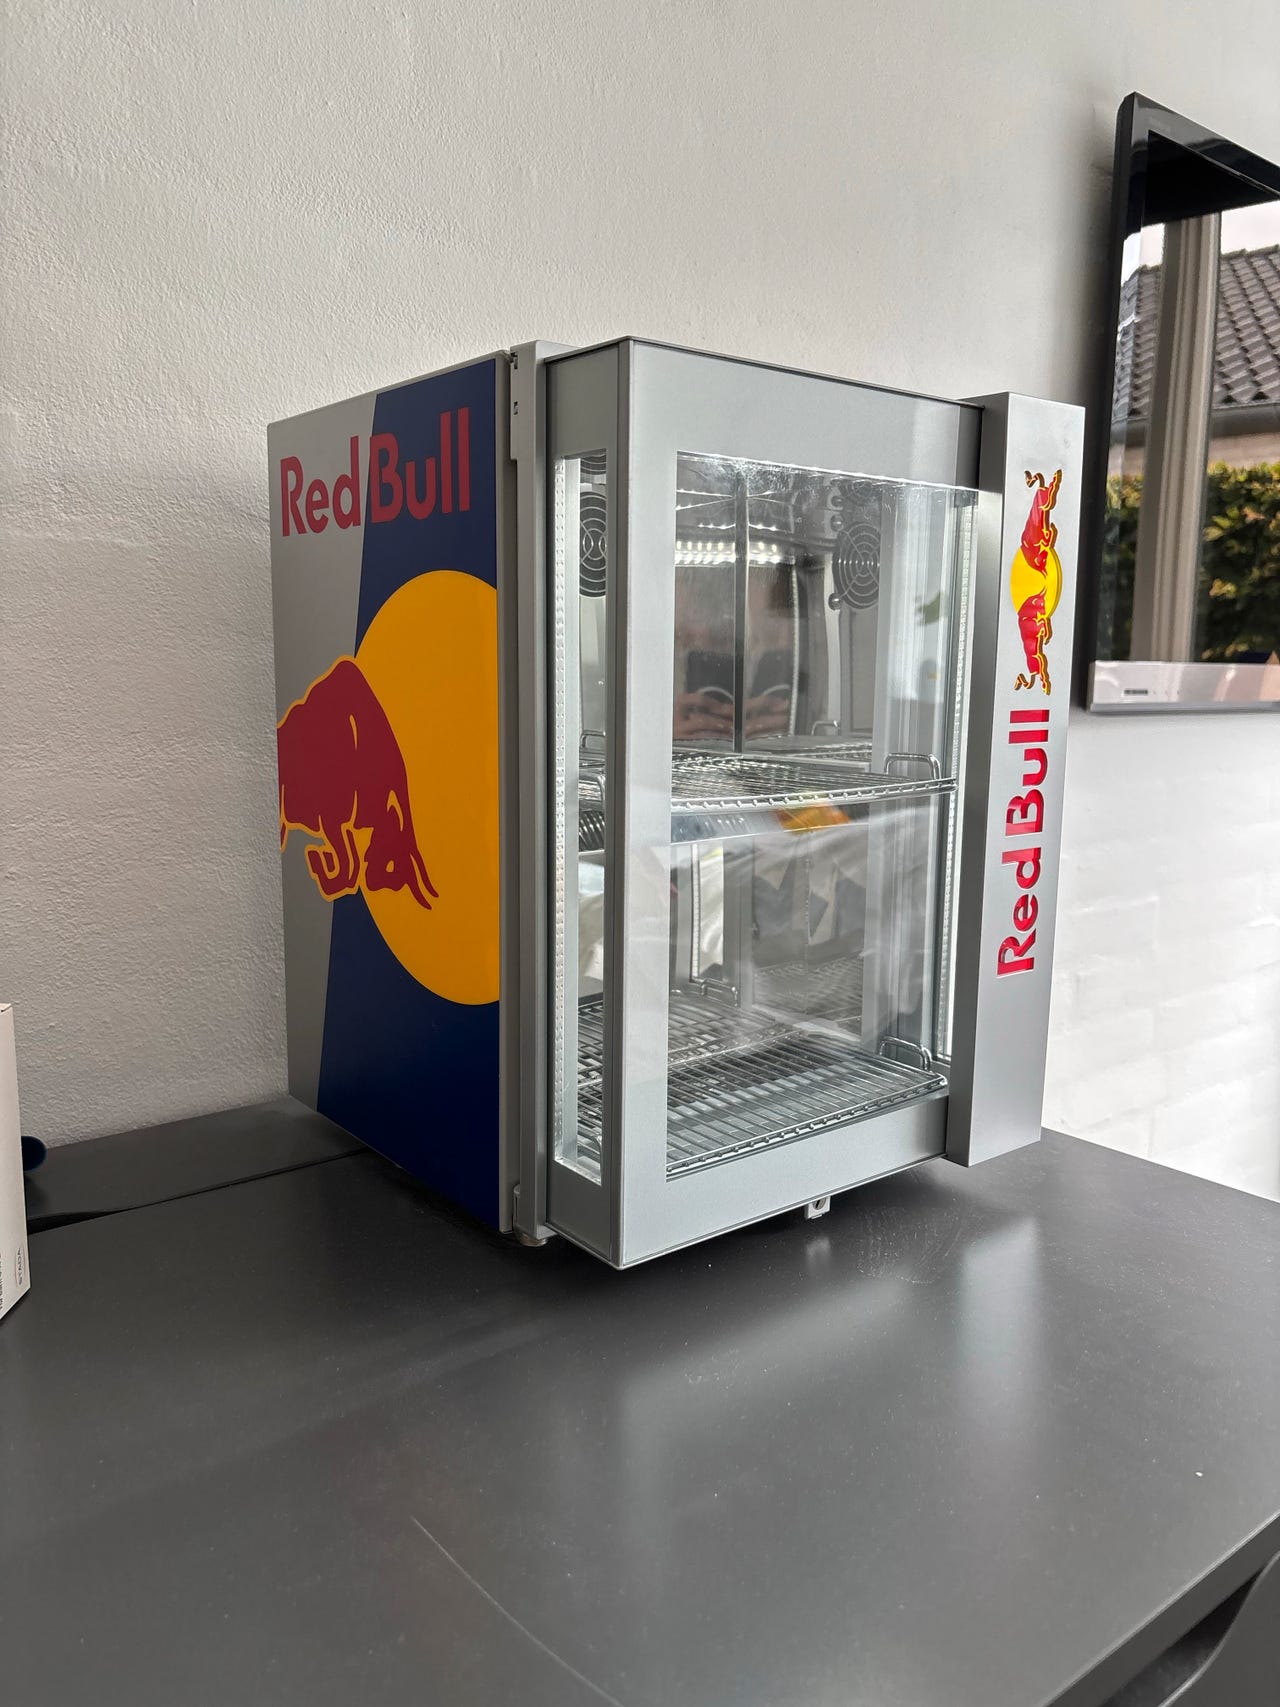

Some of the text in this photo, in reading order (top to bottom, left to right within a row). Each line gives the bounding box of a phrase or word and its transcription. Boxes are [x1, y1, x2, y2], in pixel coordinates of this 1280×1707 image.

[280, 407, 470, 537] Red Bull
[997, 709, 1050, 977] Red Bull
